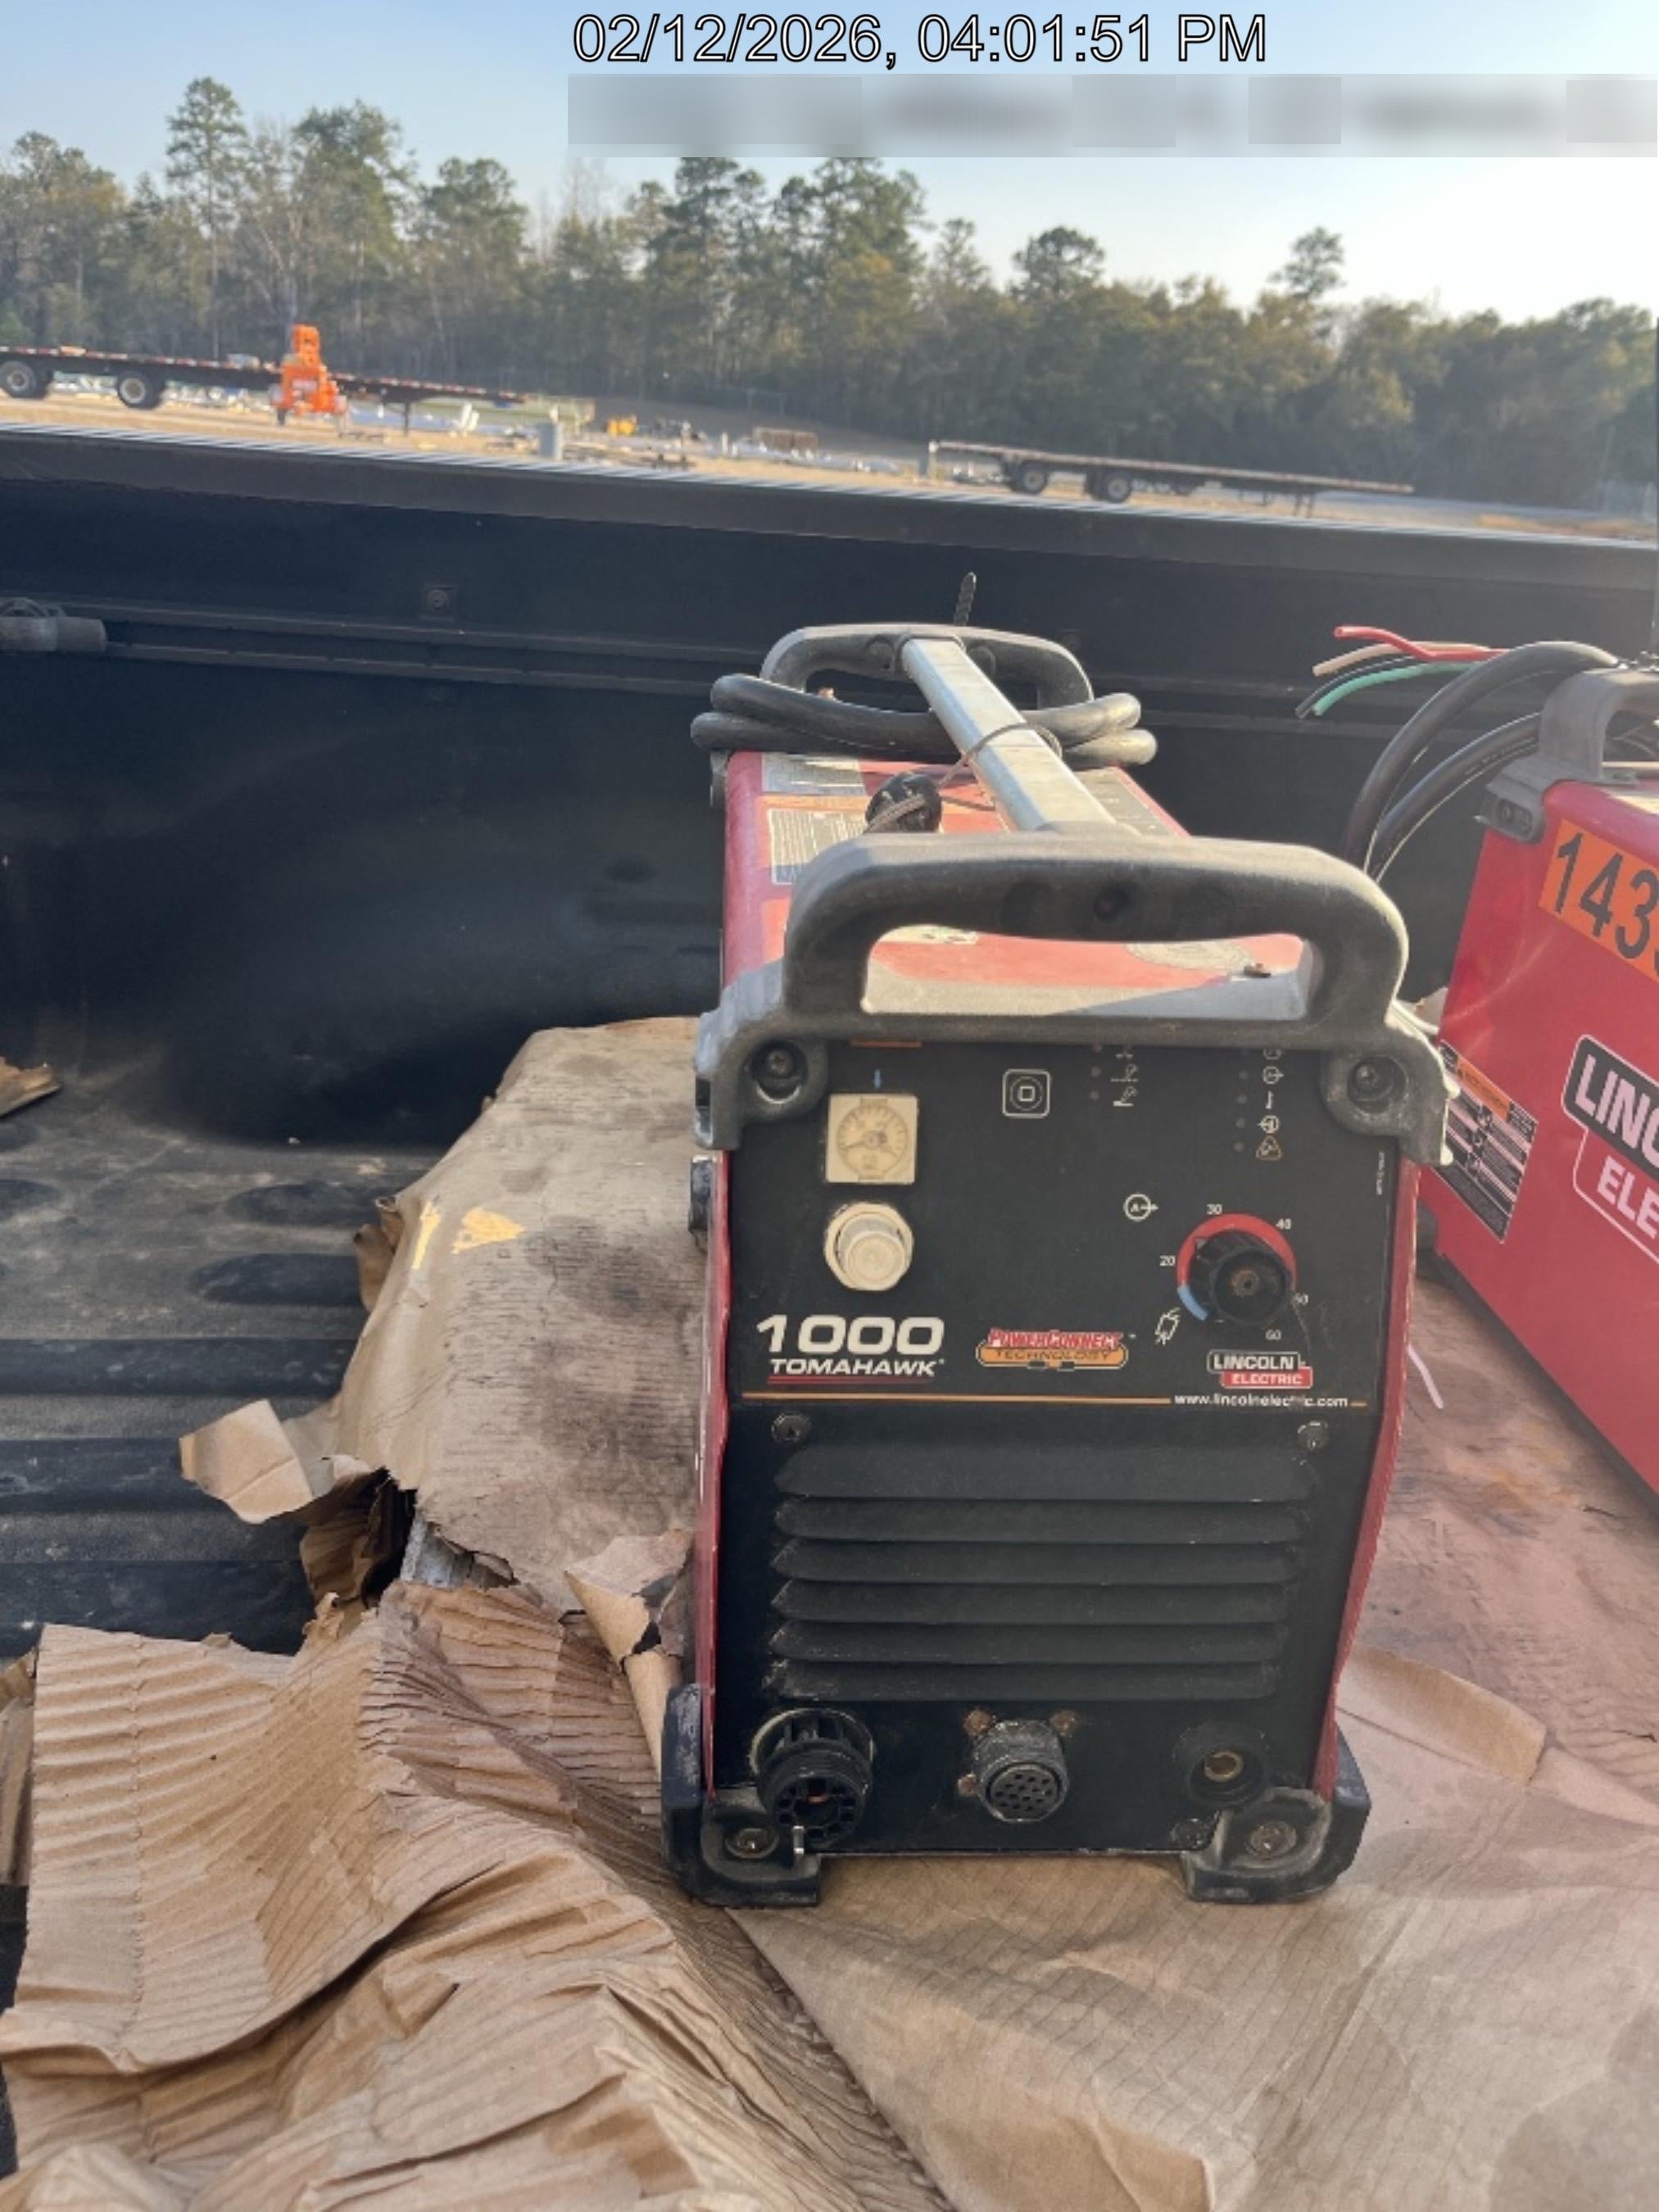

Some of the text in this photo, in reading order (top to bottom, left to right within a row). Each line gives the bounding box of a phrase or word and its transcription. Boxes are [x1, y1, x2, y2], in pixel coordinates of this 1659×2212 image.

[1556, 833, 1659, 977] 143
[1206, 1203, 1222, 1215] 30
[1275, 1218, 1292, 1230] 40
[1159, 1254, 1176, 1267] 20
[756, 1314, 945, 1355] 1000
[1265, 1329, 1281, 1340] 60
[770, 1358, 936, 1377] TOMAHAWK
[1213, 1356, 1294, 1370] LINCOLN
[1231, 1373, 1303, 1385] ELECTRIC
[1174, 1393, 1349, 1407] www.lincolnelecc.com
